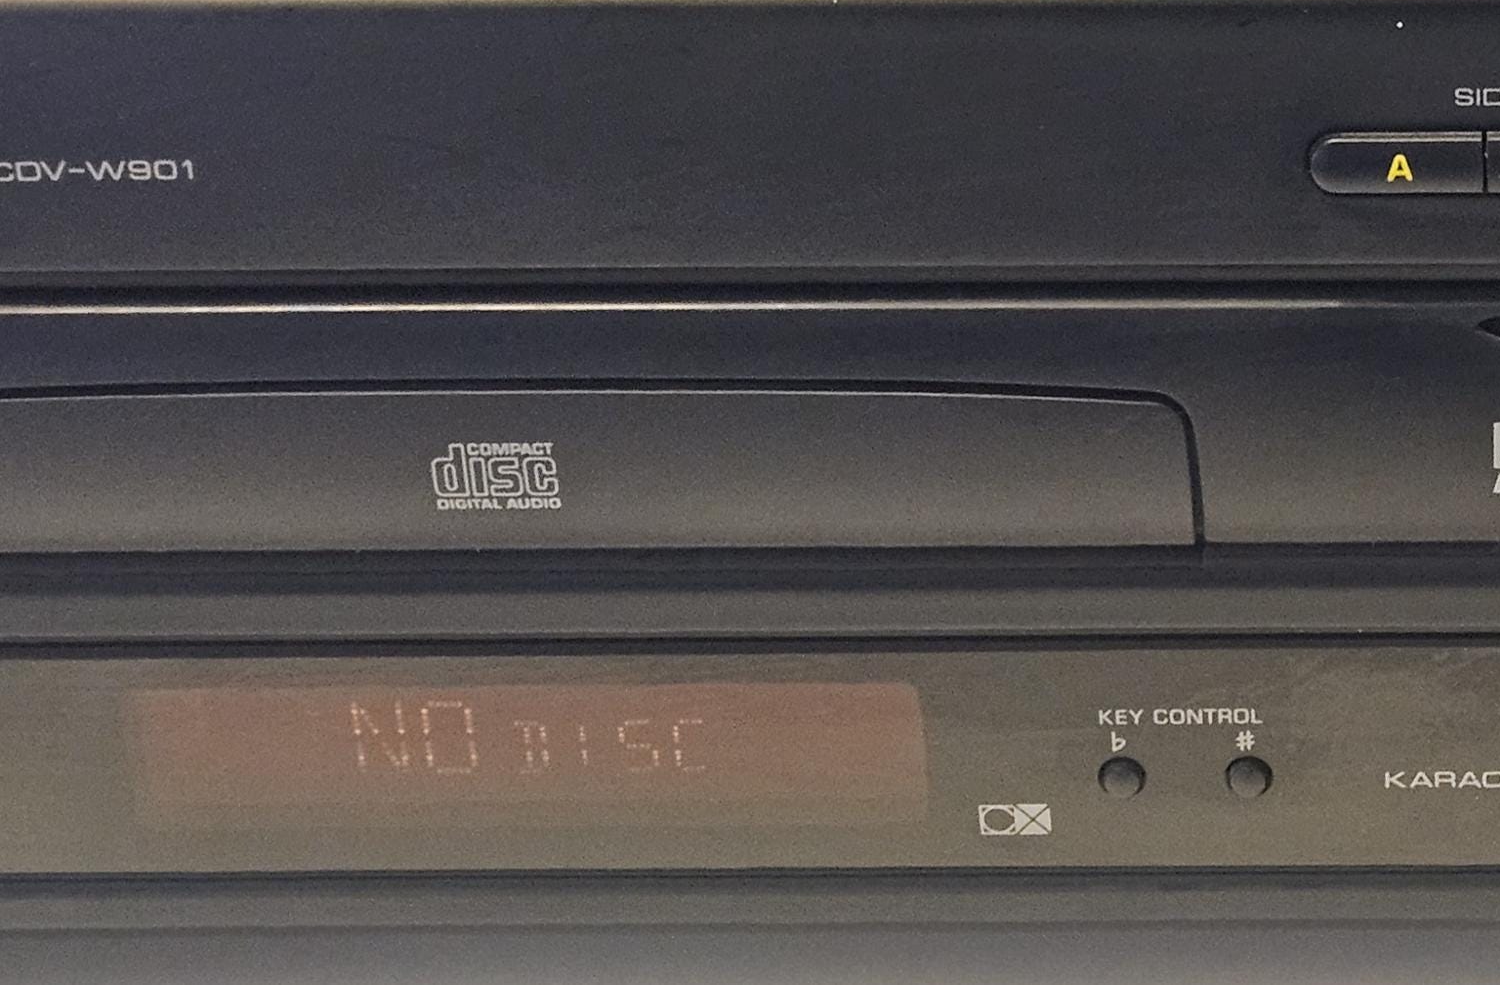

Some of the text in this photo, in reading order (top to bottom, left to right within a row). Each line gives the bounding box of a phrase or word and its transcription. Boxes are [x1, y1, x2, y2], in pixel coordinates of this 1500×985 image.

[1386, 155, 1413, 183] A
[467, 442, 554, 456] COMPACT
[431, 443, 559, 498] disc
[436, 497, 562, 509] DIGITAL AUDIO
[1098, 707, 1263, 726] KEY CONTROL
[350, 700, 706, 775] NO DISC
